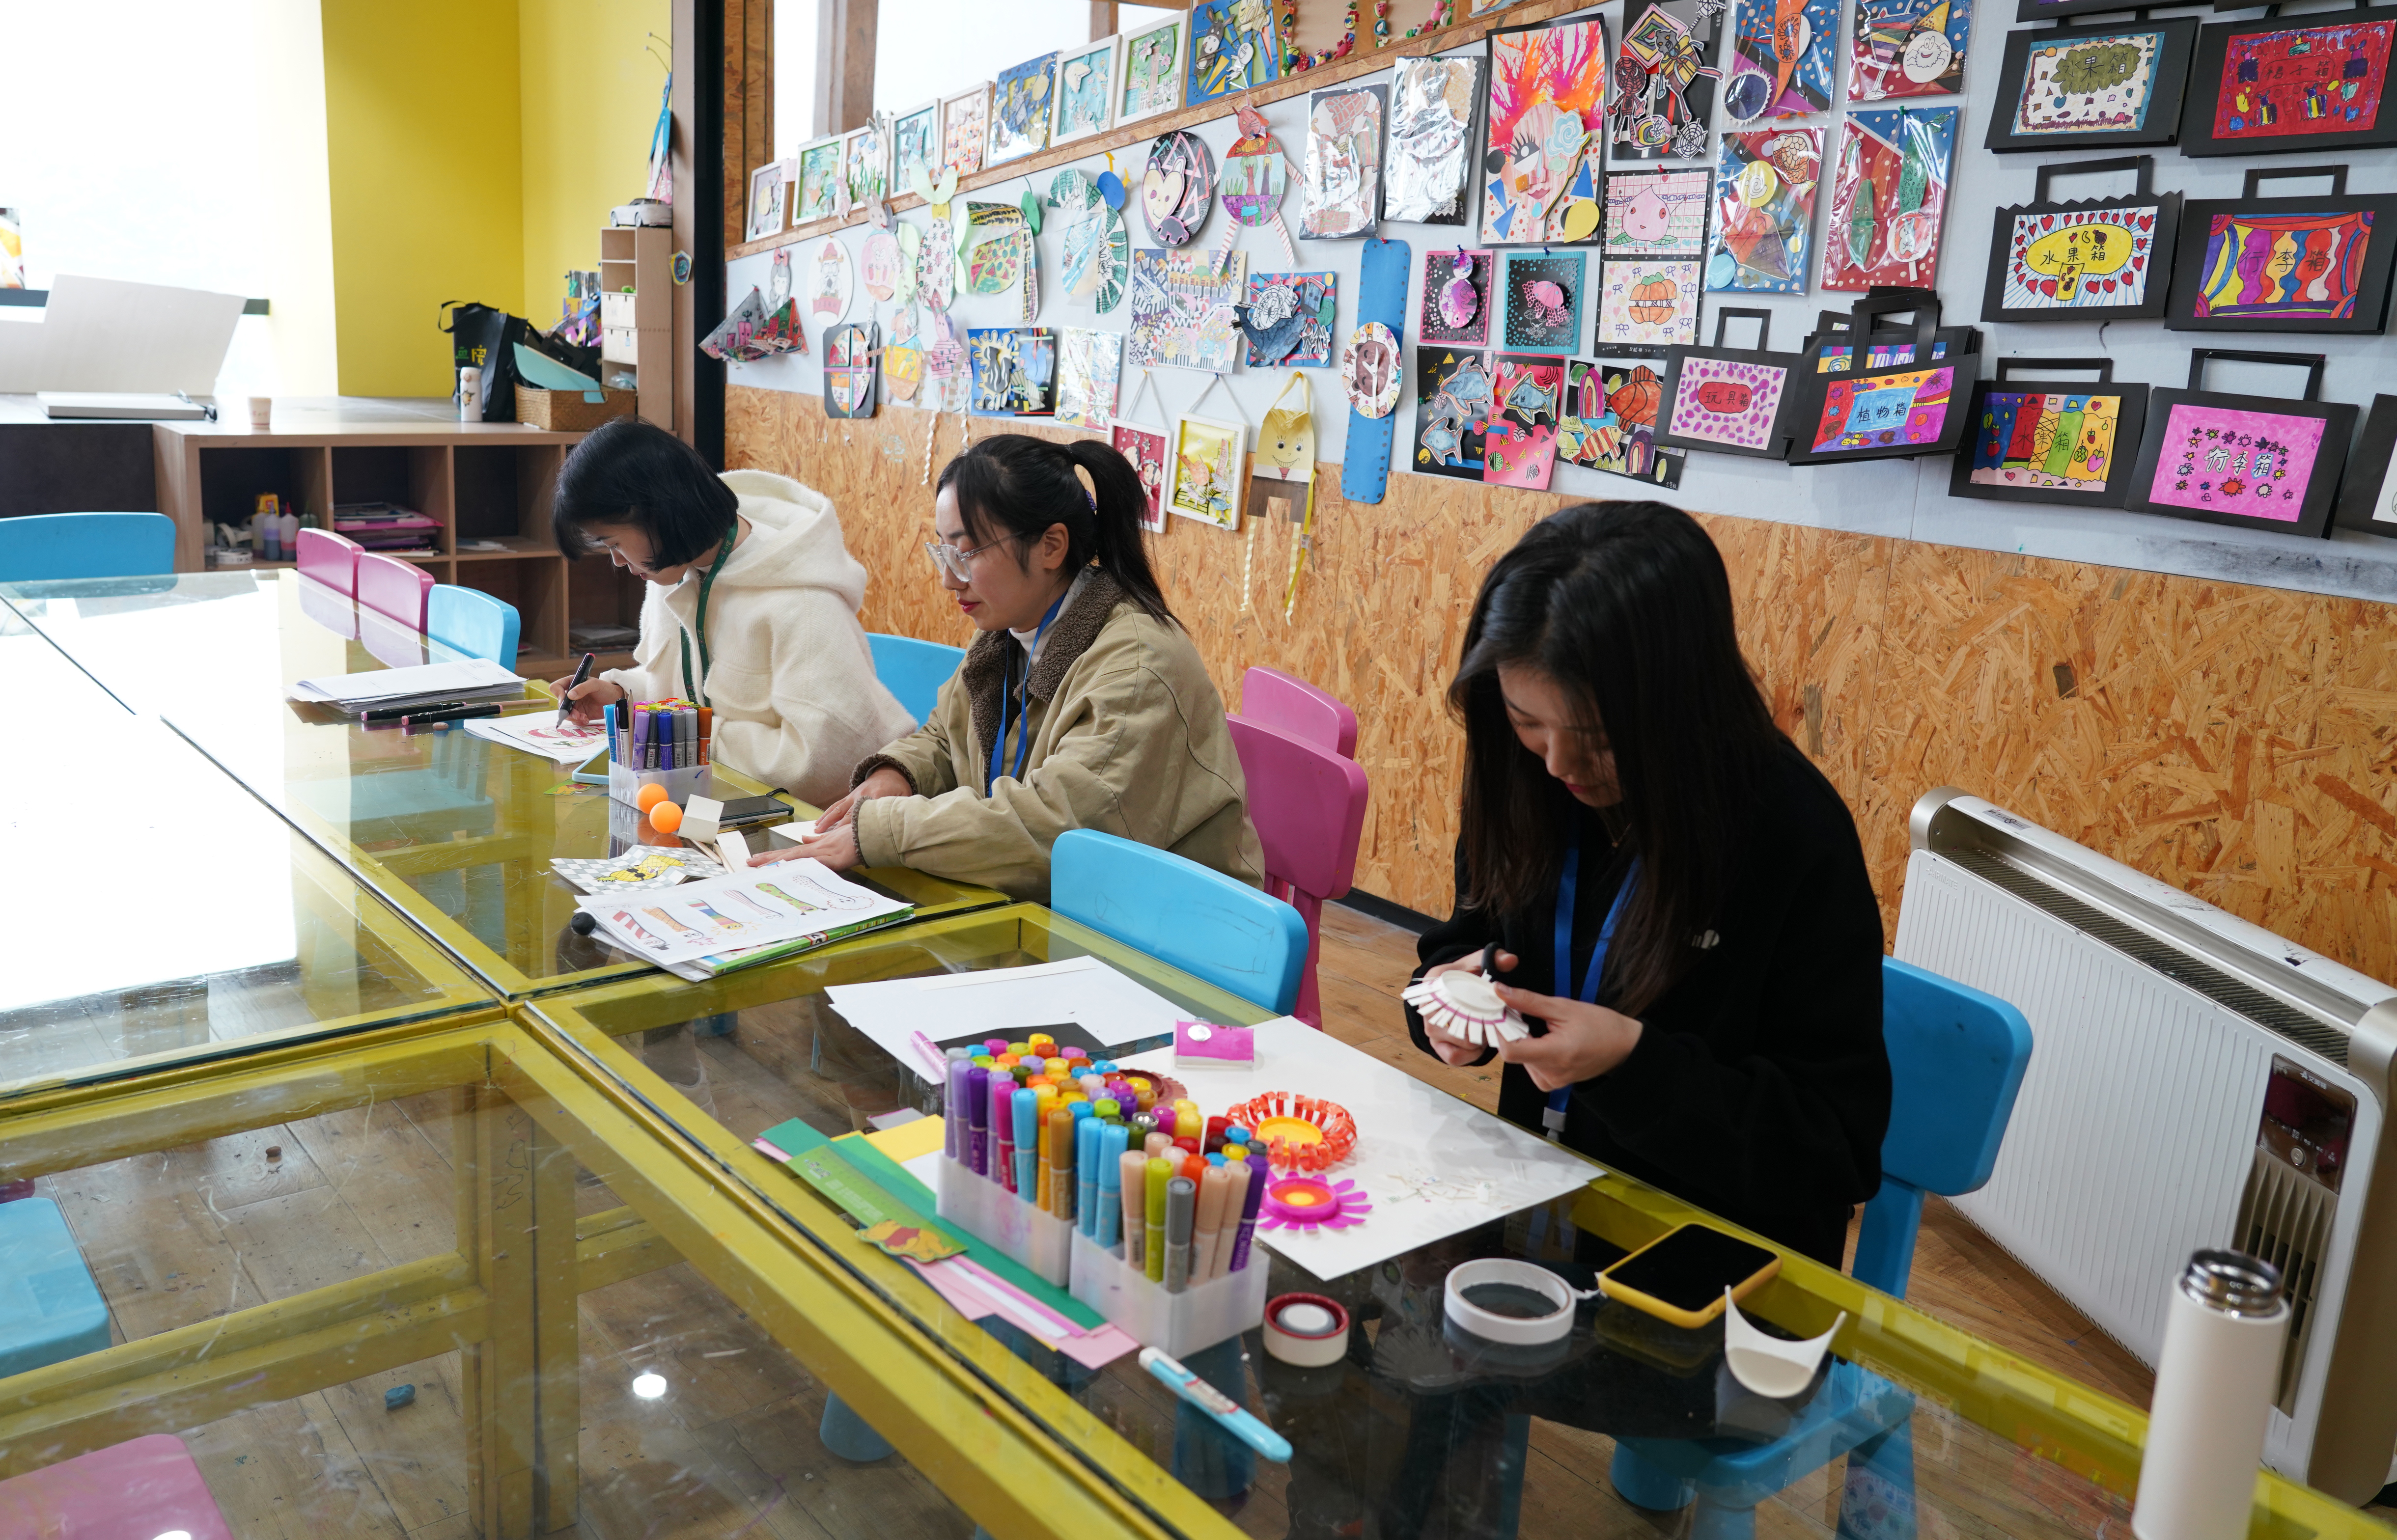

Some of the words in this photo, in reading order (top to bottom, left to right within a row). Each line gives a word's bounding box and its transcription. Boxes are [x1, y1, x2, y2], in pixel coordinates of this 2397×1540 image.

[2063, 52, 2129, 82] 水果箱
[2039, 245, 2106, 266] 水果箱
[2239, 248, 2325, 276] 行李箱
[1704, 391, 1749, 407] 玩具箱
[1856, 402, 1906, 424] 植物箱
[2016, 424, 2069, 452] 水果箱
[2205, 446, 2273, 477] 行李箱
